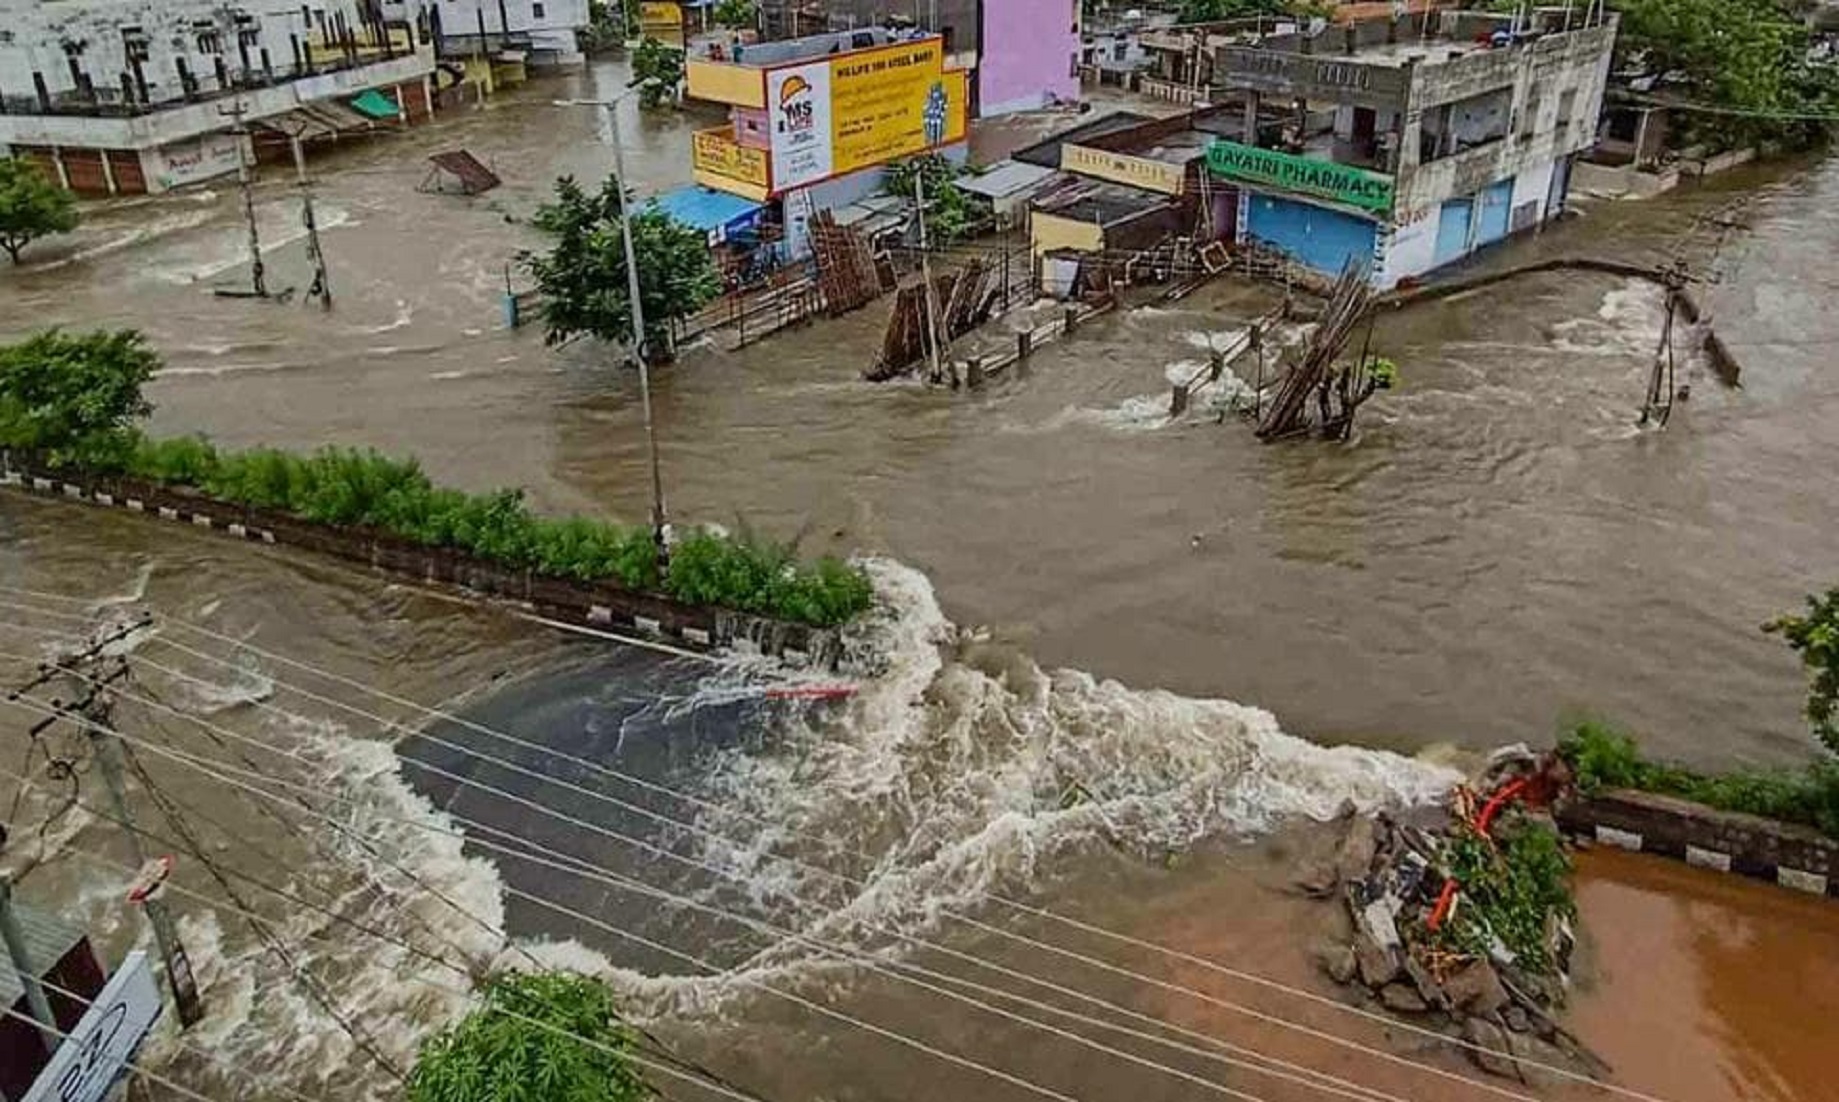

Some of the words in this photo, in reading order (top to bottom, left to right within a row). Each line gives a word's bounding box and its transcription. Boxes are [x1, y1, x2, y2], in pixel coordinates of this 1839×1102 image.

[784, 101, 812, 119] MS
[1211, 147, 1278, 175] GAYATRI
[1283, 161, 1390, 199] PHARMACY
